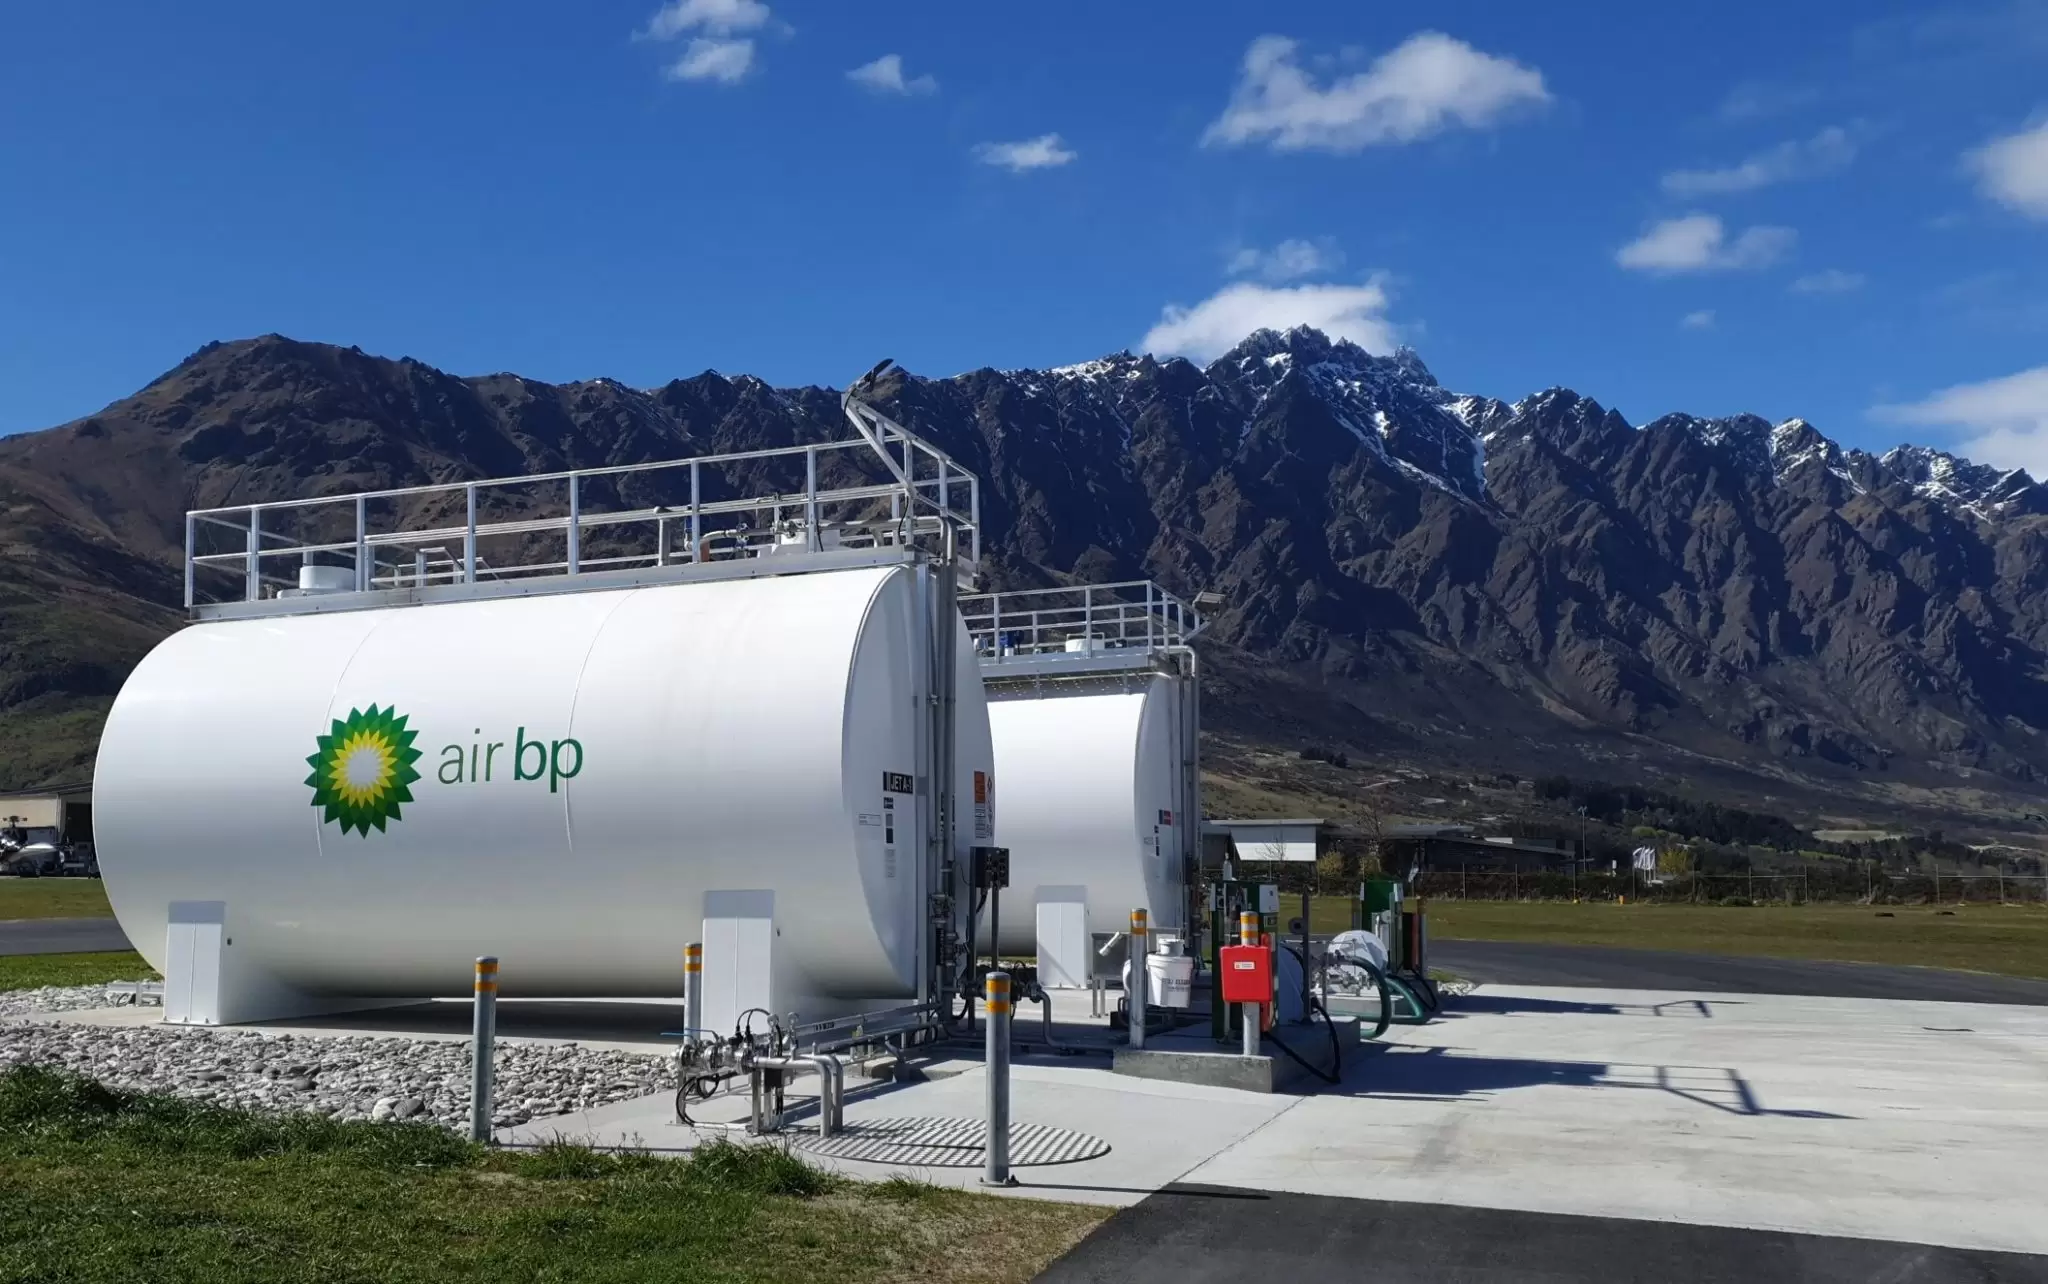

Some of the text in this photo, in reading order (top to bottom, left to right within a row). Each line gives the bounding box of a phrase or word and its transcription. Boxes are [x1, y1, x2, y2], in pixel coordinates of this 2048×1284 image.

[438, 727, 583, 793] air bp
[890, 775, 903, 791] JET
